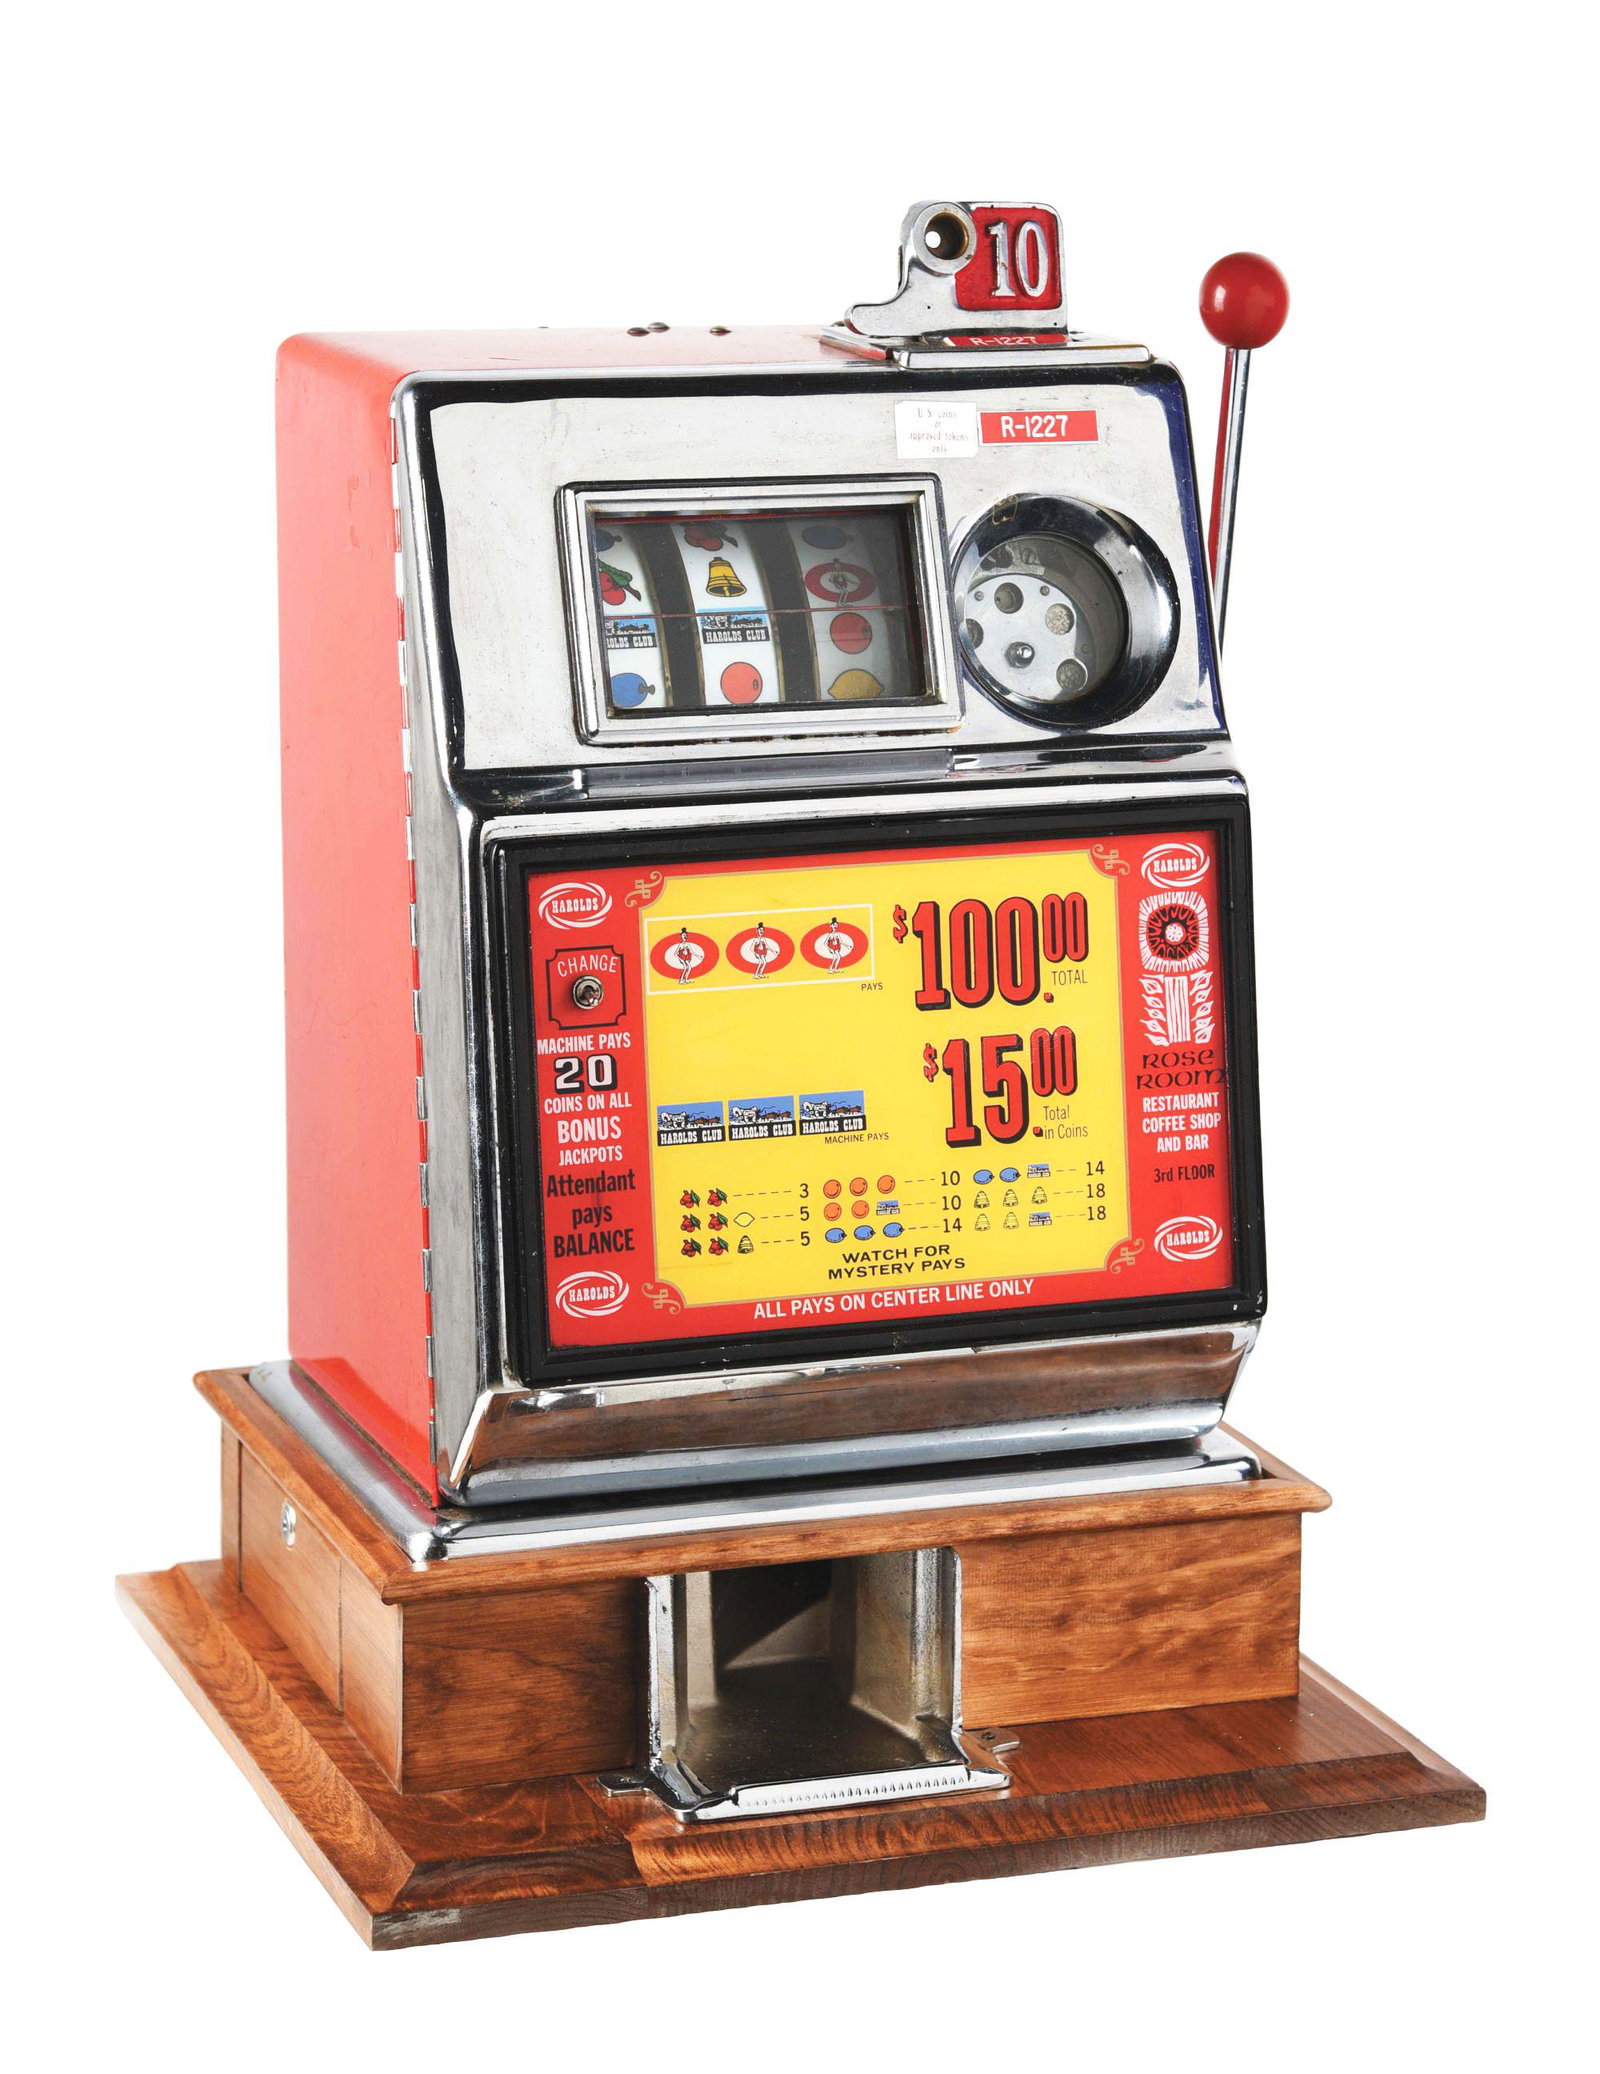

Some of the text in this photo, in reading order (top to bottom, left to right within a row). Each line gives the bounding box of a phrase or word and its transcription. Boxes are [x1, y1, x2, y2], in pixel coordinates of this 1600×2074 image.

[989, 220, 1048, 297] 10
[968, 336, 1038, 347] R-1227
[1000, 414, 1069, 438] R-1227
[633, 635, 653, 647] CLUB
[705, 629, 766, 642] HAROLDS CLUB
[1153, 857, 1197, 874] HAROLDS
[551, 897, 599, 913] HAROLDS
[557, 954, 618, 977] CHANGE
[1051, 968, 1089, 986] TOTAL
[860, 982, 884, 992] PAYS
[537, 1032, 632, 1055] MACHINE PAYS
[553, 1052, 618, 1095] 20
[543, 1091, 633, 1114] COINS ON ALL
[1142, 1091, 1220, 1113] RESTAURANT
[1042, 1104, 1070, 1121] Total
[557, 1115, 622, 1144] BONUS
[801, 1118, 864, 1134] HAROLDS CLUB
[1044, 1123, 1089, 1140] in Coins
[1142, 1112, 1222, 1134] COFFEE SHOP
[660, 1130, 723, 1145] HAROLDS CLUB
[731, 1124, 794, 1140] HAROLDS CLUB
[824, 1132, 890, 1145] MACHINE PAYS
[1156, 1134, 1209, 1153] AND BAR
[558, 1145, 623, 1166] JACKPOTS
[1085, 1160, 1105, 1177] 14
[1153, 1163, 1216, 1183] 3rd FLOOR
[546, 1168, 636, 1198] Attendant
[940, 1170, 961, 1187] 10
[799, 1183, 810, 1199] 3
[1086, 1182, 1106, 1199] 18
[941, 1194, 962, 1211] 10
[572, 1203, 613, 1230] pays
[799, 1206, 810, 1222] 5
[1087, 1205, 1107, 1221] 18
[943, 1217, 963, 1233] 14
[553, 1228, 636, 1258] BALANCE
[800, 1231, 811, 1246] 5
[1165, 1230, 1211, 1247] HAROLDS
[842, 1244, 951, 1264] WATCH FOR
[828, 1257, 966, 1280] MYSTERY PAYS
[568, 1285, 616, 1302] HAROLDS
[753, 1278, 1035, 1319] ALL PAYS ON CENTER LINE ONLY
